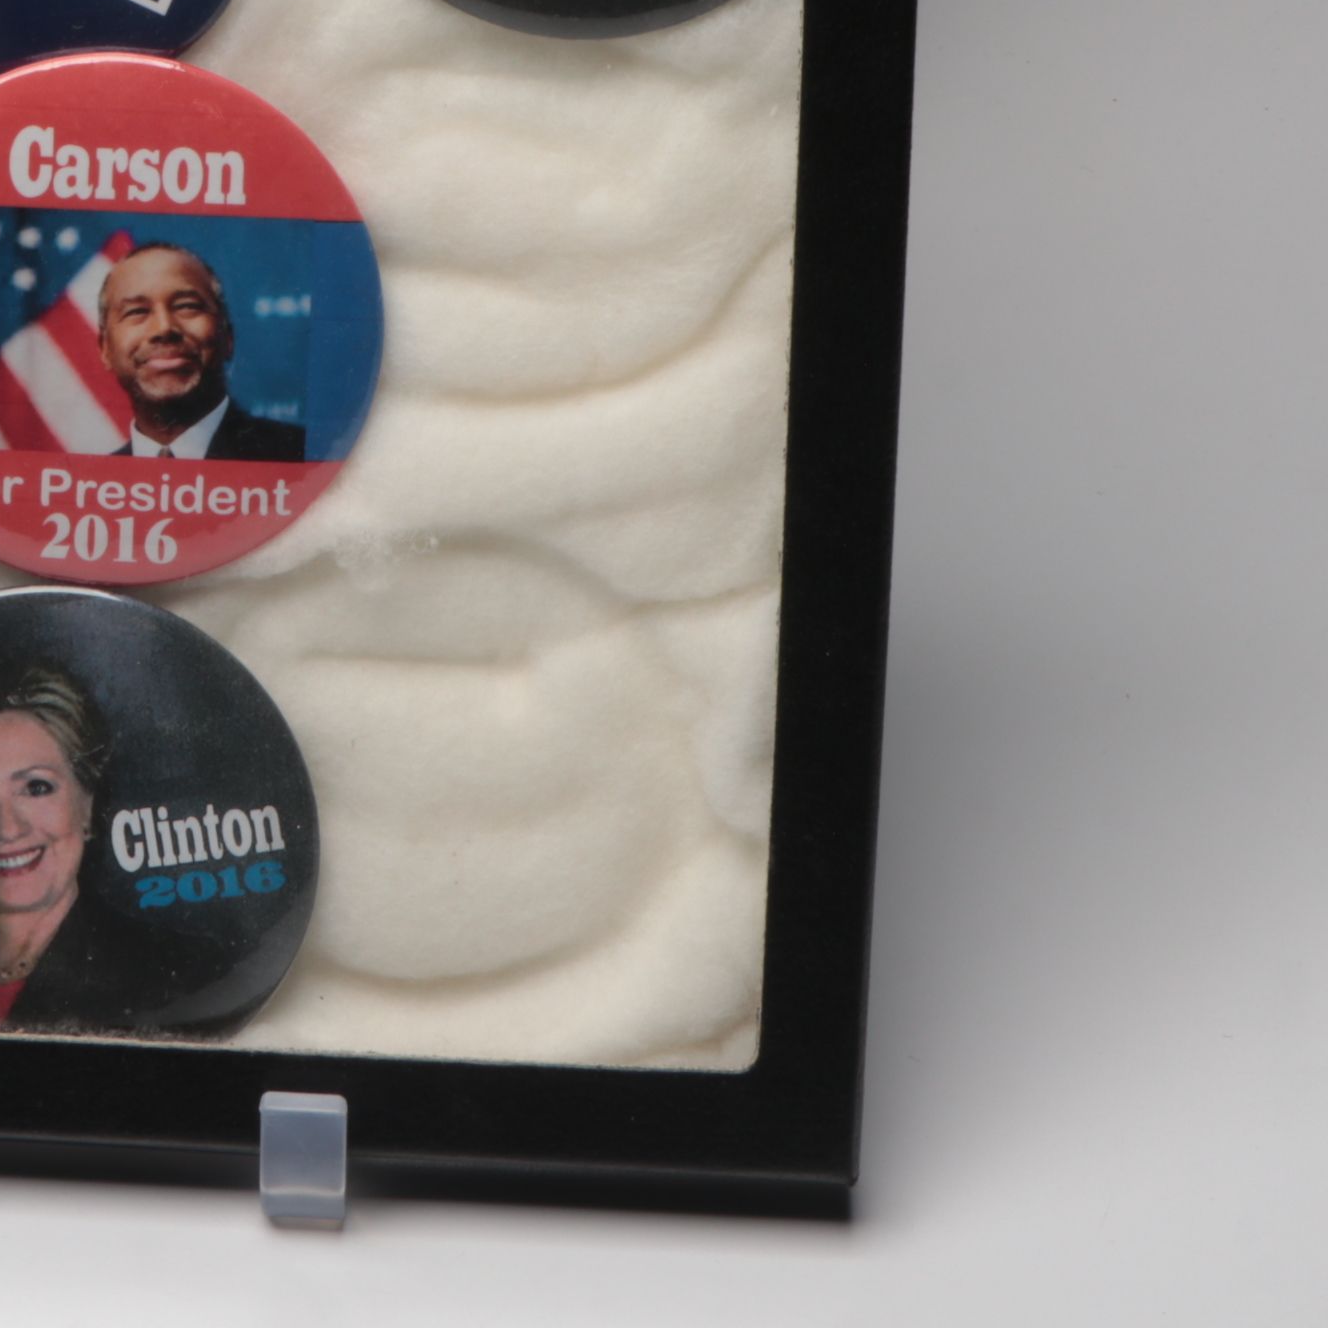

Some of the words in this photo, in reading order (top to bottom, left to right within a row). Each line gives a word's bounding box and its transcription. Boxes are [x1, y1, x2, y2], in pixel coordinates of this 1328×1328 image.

[9, 125, 246, 205] Carson
[40, 469, 291, 517] President
[39, 512, 178, 565] 2016
[111, 803, 286, 873] Clinton
[134, 860, 287, 910] 2016
